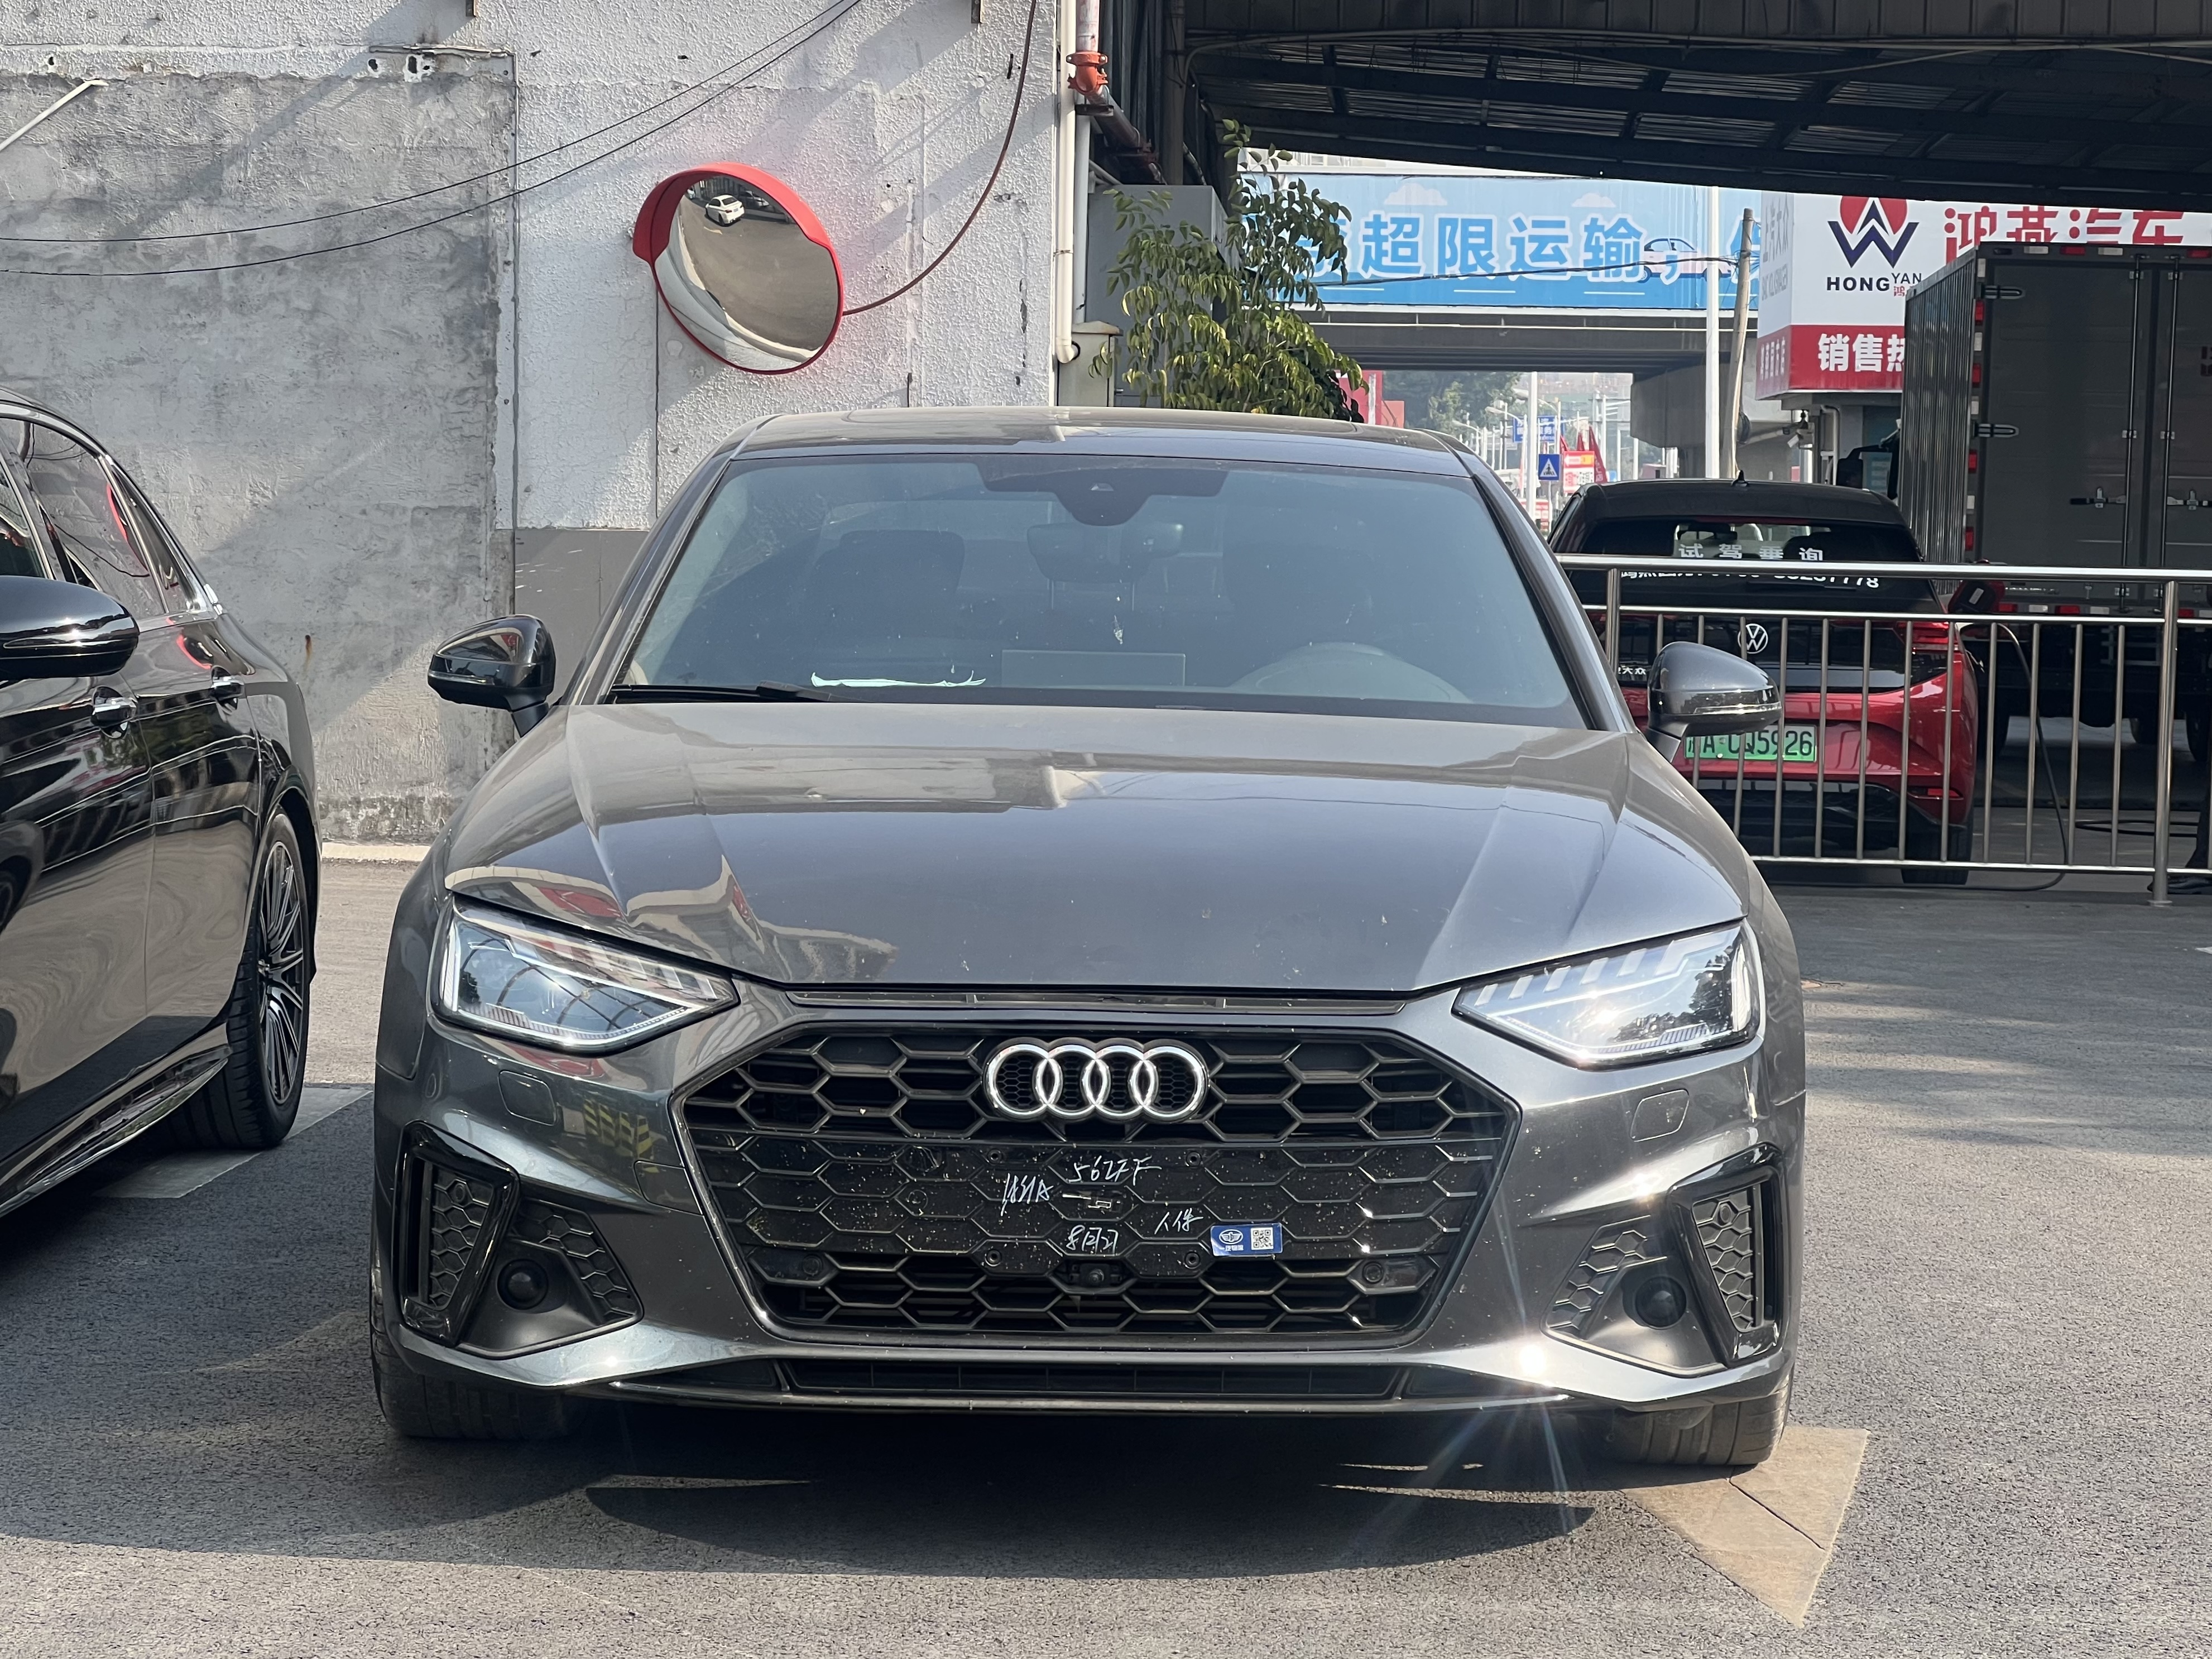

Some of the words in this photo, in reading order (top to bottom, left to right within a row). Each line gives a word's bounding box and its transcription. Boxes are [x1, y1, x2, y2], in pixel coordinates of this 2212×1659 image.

[1295, 214, 1674, 279] 超限运输，
[1827, 277, 1889, 291] HONG
[1891, 272, 1922, 284] YAN
[1618, 667, 1646, 675] 大众
